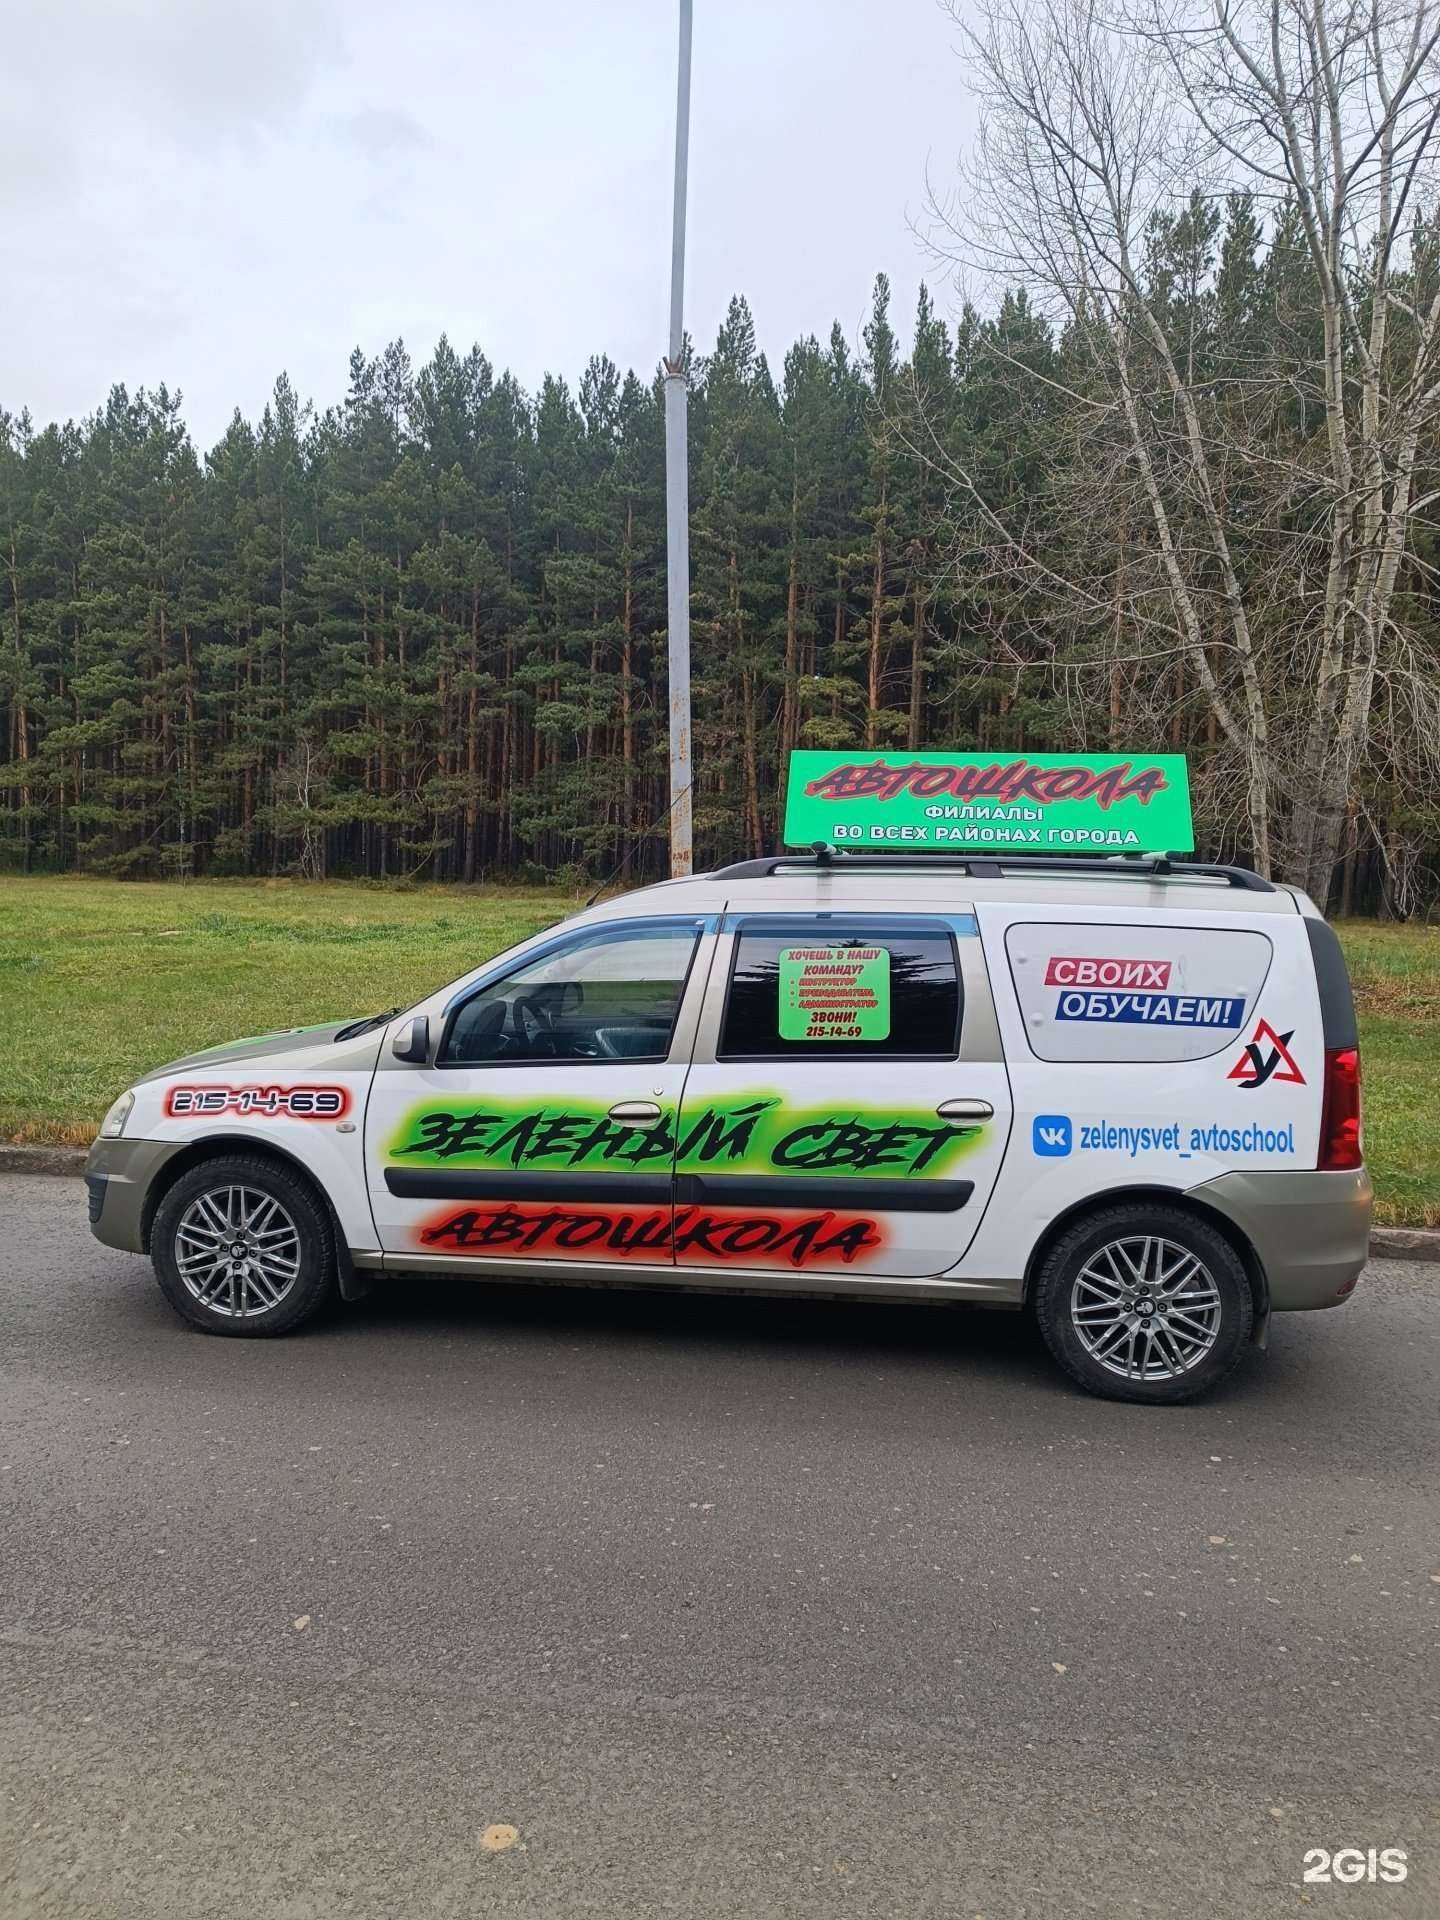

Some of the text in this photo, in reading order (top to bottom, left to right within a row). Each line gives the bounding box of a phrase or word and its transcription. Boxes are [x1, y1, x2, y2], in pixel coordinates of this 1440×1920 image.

[806, 760, 1169, 809] АВТОШКОЛА
[924, 805, 1043, 821] ФИЛИАЛЫ
[833, 825, 1139, 845] ВО ВСЕХ РАЙОНАХ ГОРОДА
[788, 950, 880, 960] ХОЧЕШЬ В НАШУ
[804, 965, 864, 975] КОМАНДУ?
[1054, 960, 1169, 987] СВОИХ
[811, 1012, 858, 1023] ЗВОНИ!
[1062, 993, 1233, 1024] ОБУЧАЕМ!
[806, 1026, 862, 1037] 215-14-69
[1237, 1030, 1295, 1088] У
[173, 1091, 341, 1112] 215-14-69
[391, 1098, 982, 1174] ЗЕЛЕНЫЙ СВЕТ
[1080, 1119, 1295, 1158] zelenysvet_avtoschool
[422, 1205, 879, 1264] АВТОШКОЛА
